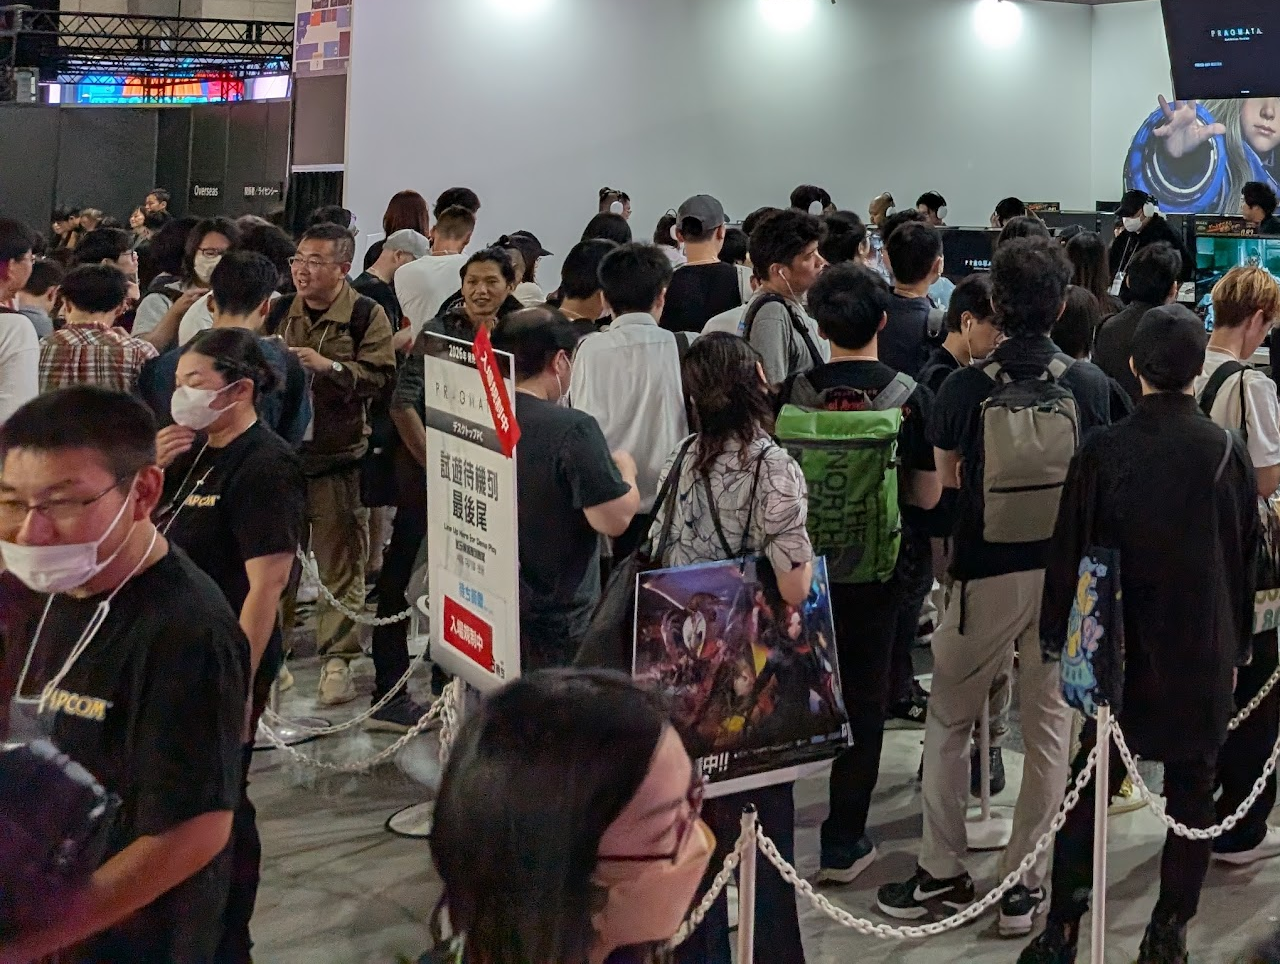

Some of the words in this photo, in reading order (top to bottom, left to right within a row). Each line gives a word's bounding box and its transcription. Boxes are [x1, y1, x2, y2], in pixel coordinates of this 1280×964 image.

[194, 185, 218, 196] Overseas
[440, 450, 498, 501] 試遊待機列
[822, 450, 849, 546] NORTH
[453, 489, 487, 532] 最後尾
